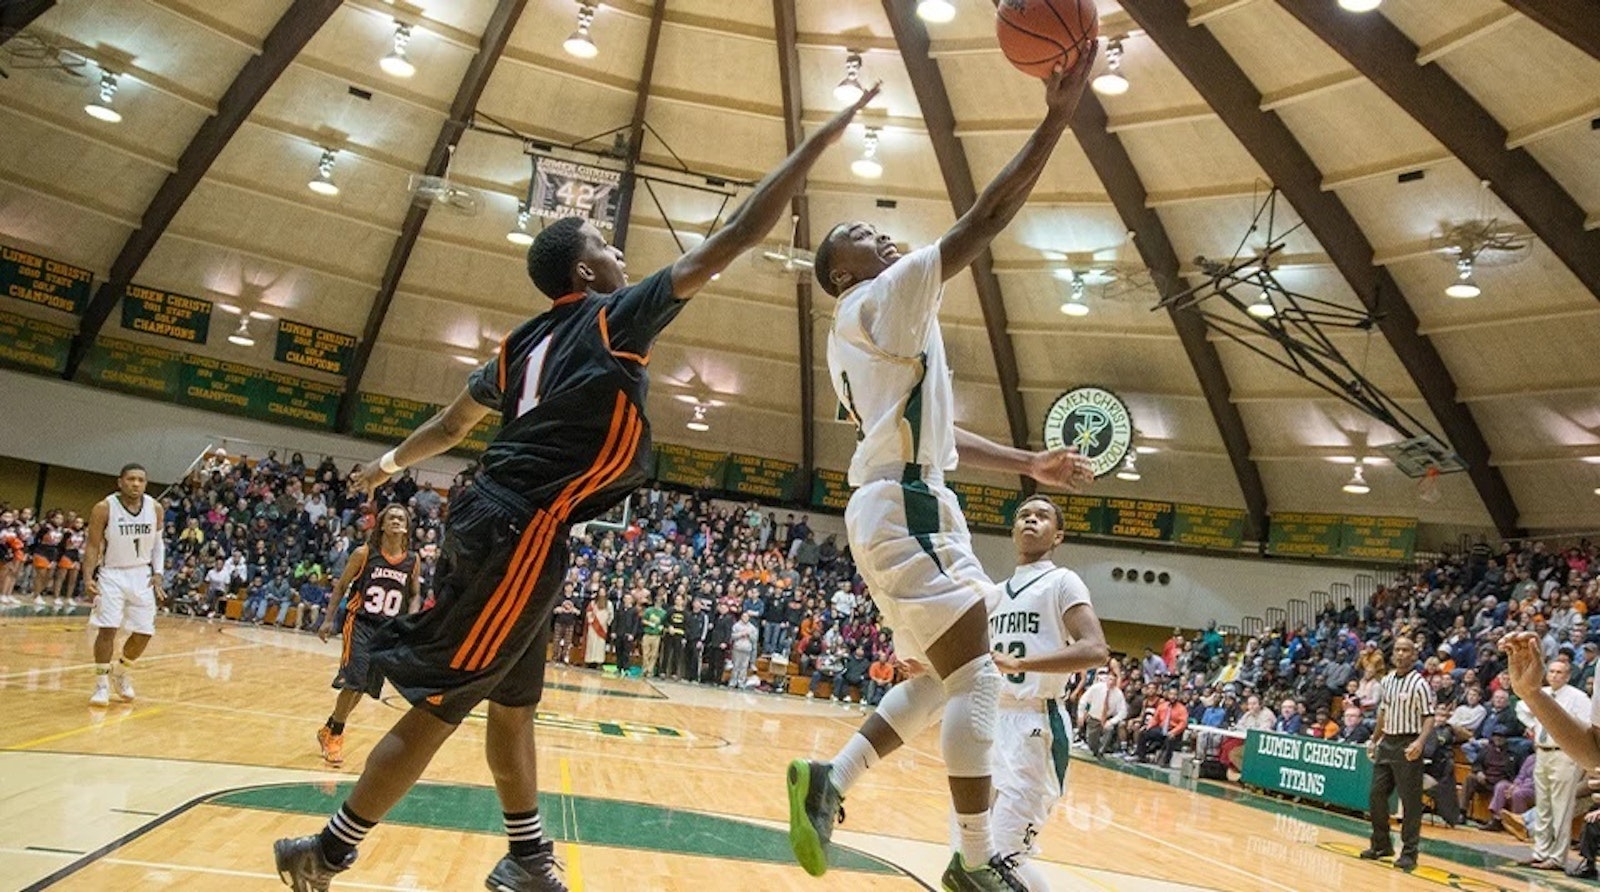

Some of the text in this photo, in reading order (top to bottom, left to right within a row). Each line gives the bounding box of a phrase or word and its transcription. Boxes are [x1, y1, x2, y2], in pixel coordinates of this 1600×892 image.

[556, 181, 595, 211] 42
[2, 247, 91, 283] LUMEN CHRISTI
[33, 280, 56, 292] GOLF
[45, 273, 73, 288] STATE
[9, 284, 75, 311] CHAMPIONS
[126, 285, 212, 314] LUMEN CHRISTI
[154, 313, 178, 324] GOLF
[165, 306, 193, 319] STATE
[133, 317, 196, 340] CHAMPIONS
[280, 320, 355, 348] LUMEN CHRISTI
[286, 351, 341, 373] CHAMPIONS
[517, 332, 554, 418] 1
[187, 386, 249, 407] CHAMPIONS
[268, 402, 327, 423] CHAMPIONS
[1048, 390, 1128, 435] LUMEN CHRISTI
[737, 481, 783, 497] CHAMPIONS
[984, 486, 1017, 500] CHRISTI
[1106, 499, 1171, 513] LUMEN CHRISTI
[118, 523, 152, 536] TITANS
[1112, 524, 1161, 538] CHAMPIONS
[1180, 532, 1234, 547] CHAMPIONS
[133, 538, 140, 557] 1
[364, 585, 403, 617] 30
[990, 611, 1040, 639] TITANS
[1258, 734, 1358, 771] LUMEN CHRISTI
[1279, 766, 1326, 796] TITANS
